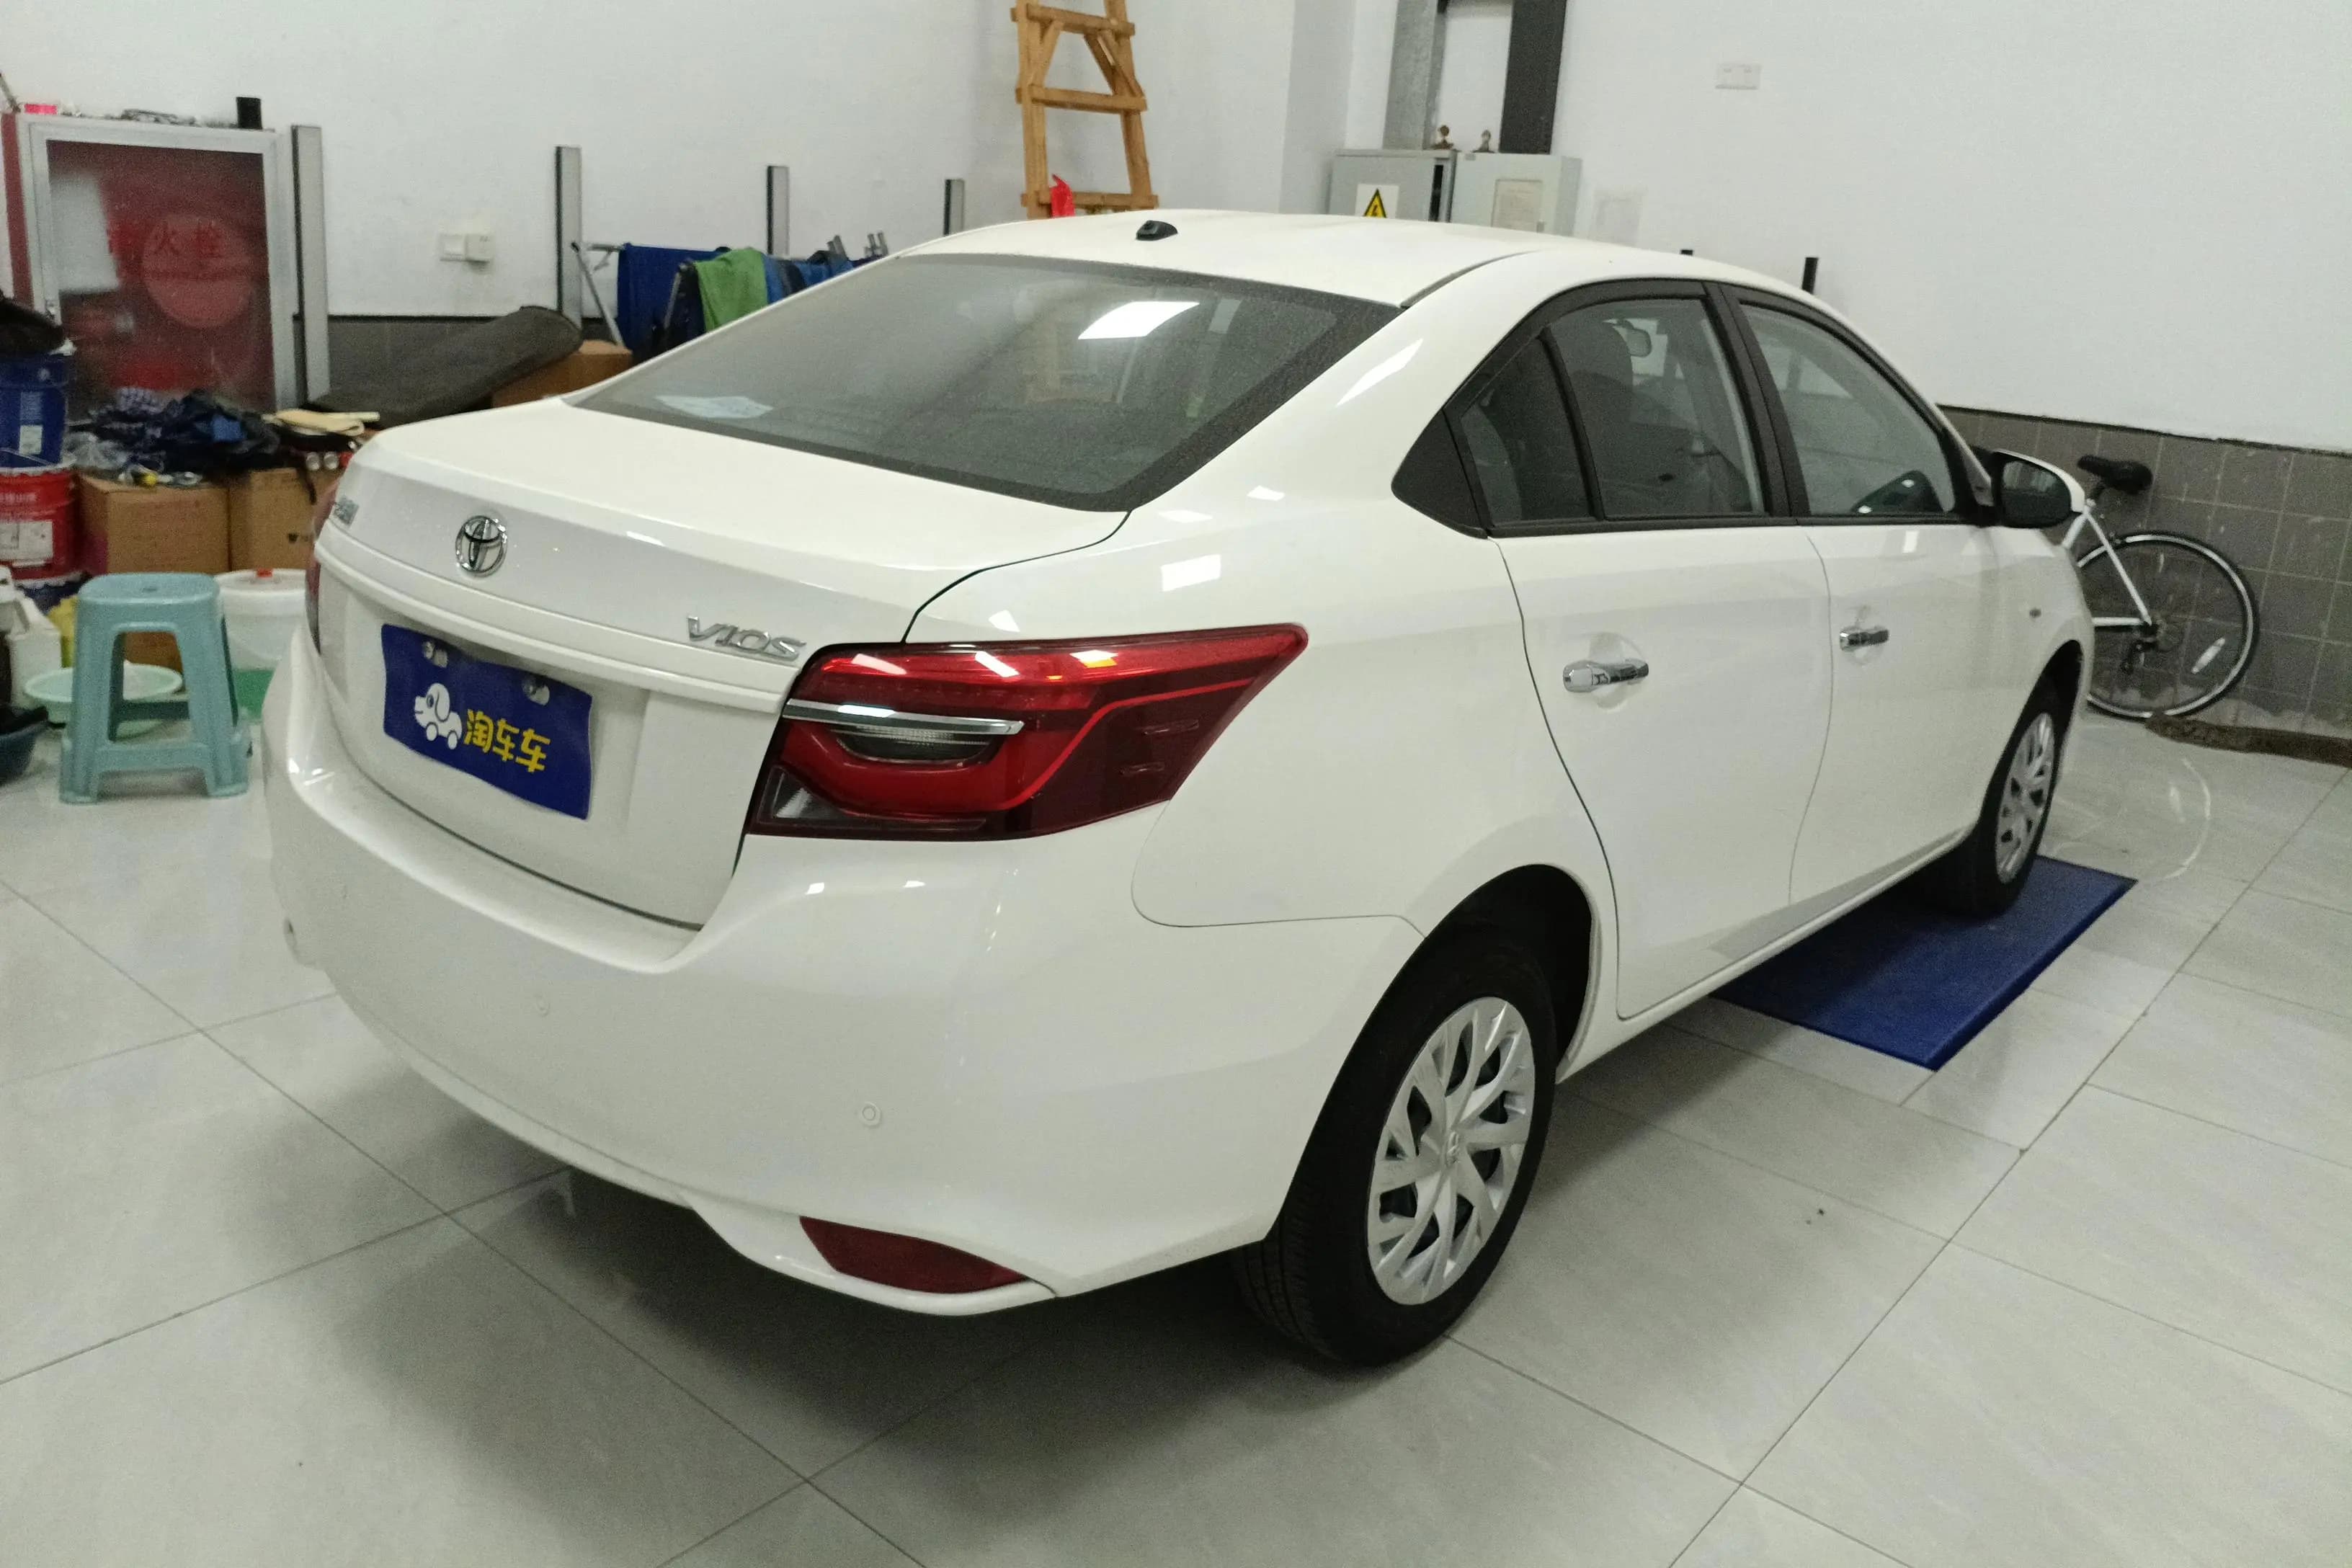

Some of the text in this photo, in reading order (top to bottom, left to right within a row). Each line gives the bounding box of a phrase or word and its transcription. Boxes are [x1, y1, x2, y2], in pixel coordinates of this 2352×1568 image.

[687, 615, 807, 662] VIOS
[463, 709, 551, 773] 淘车车
